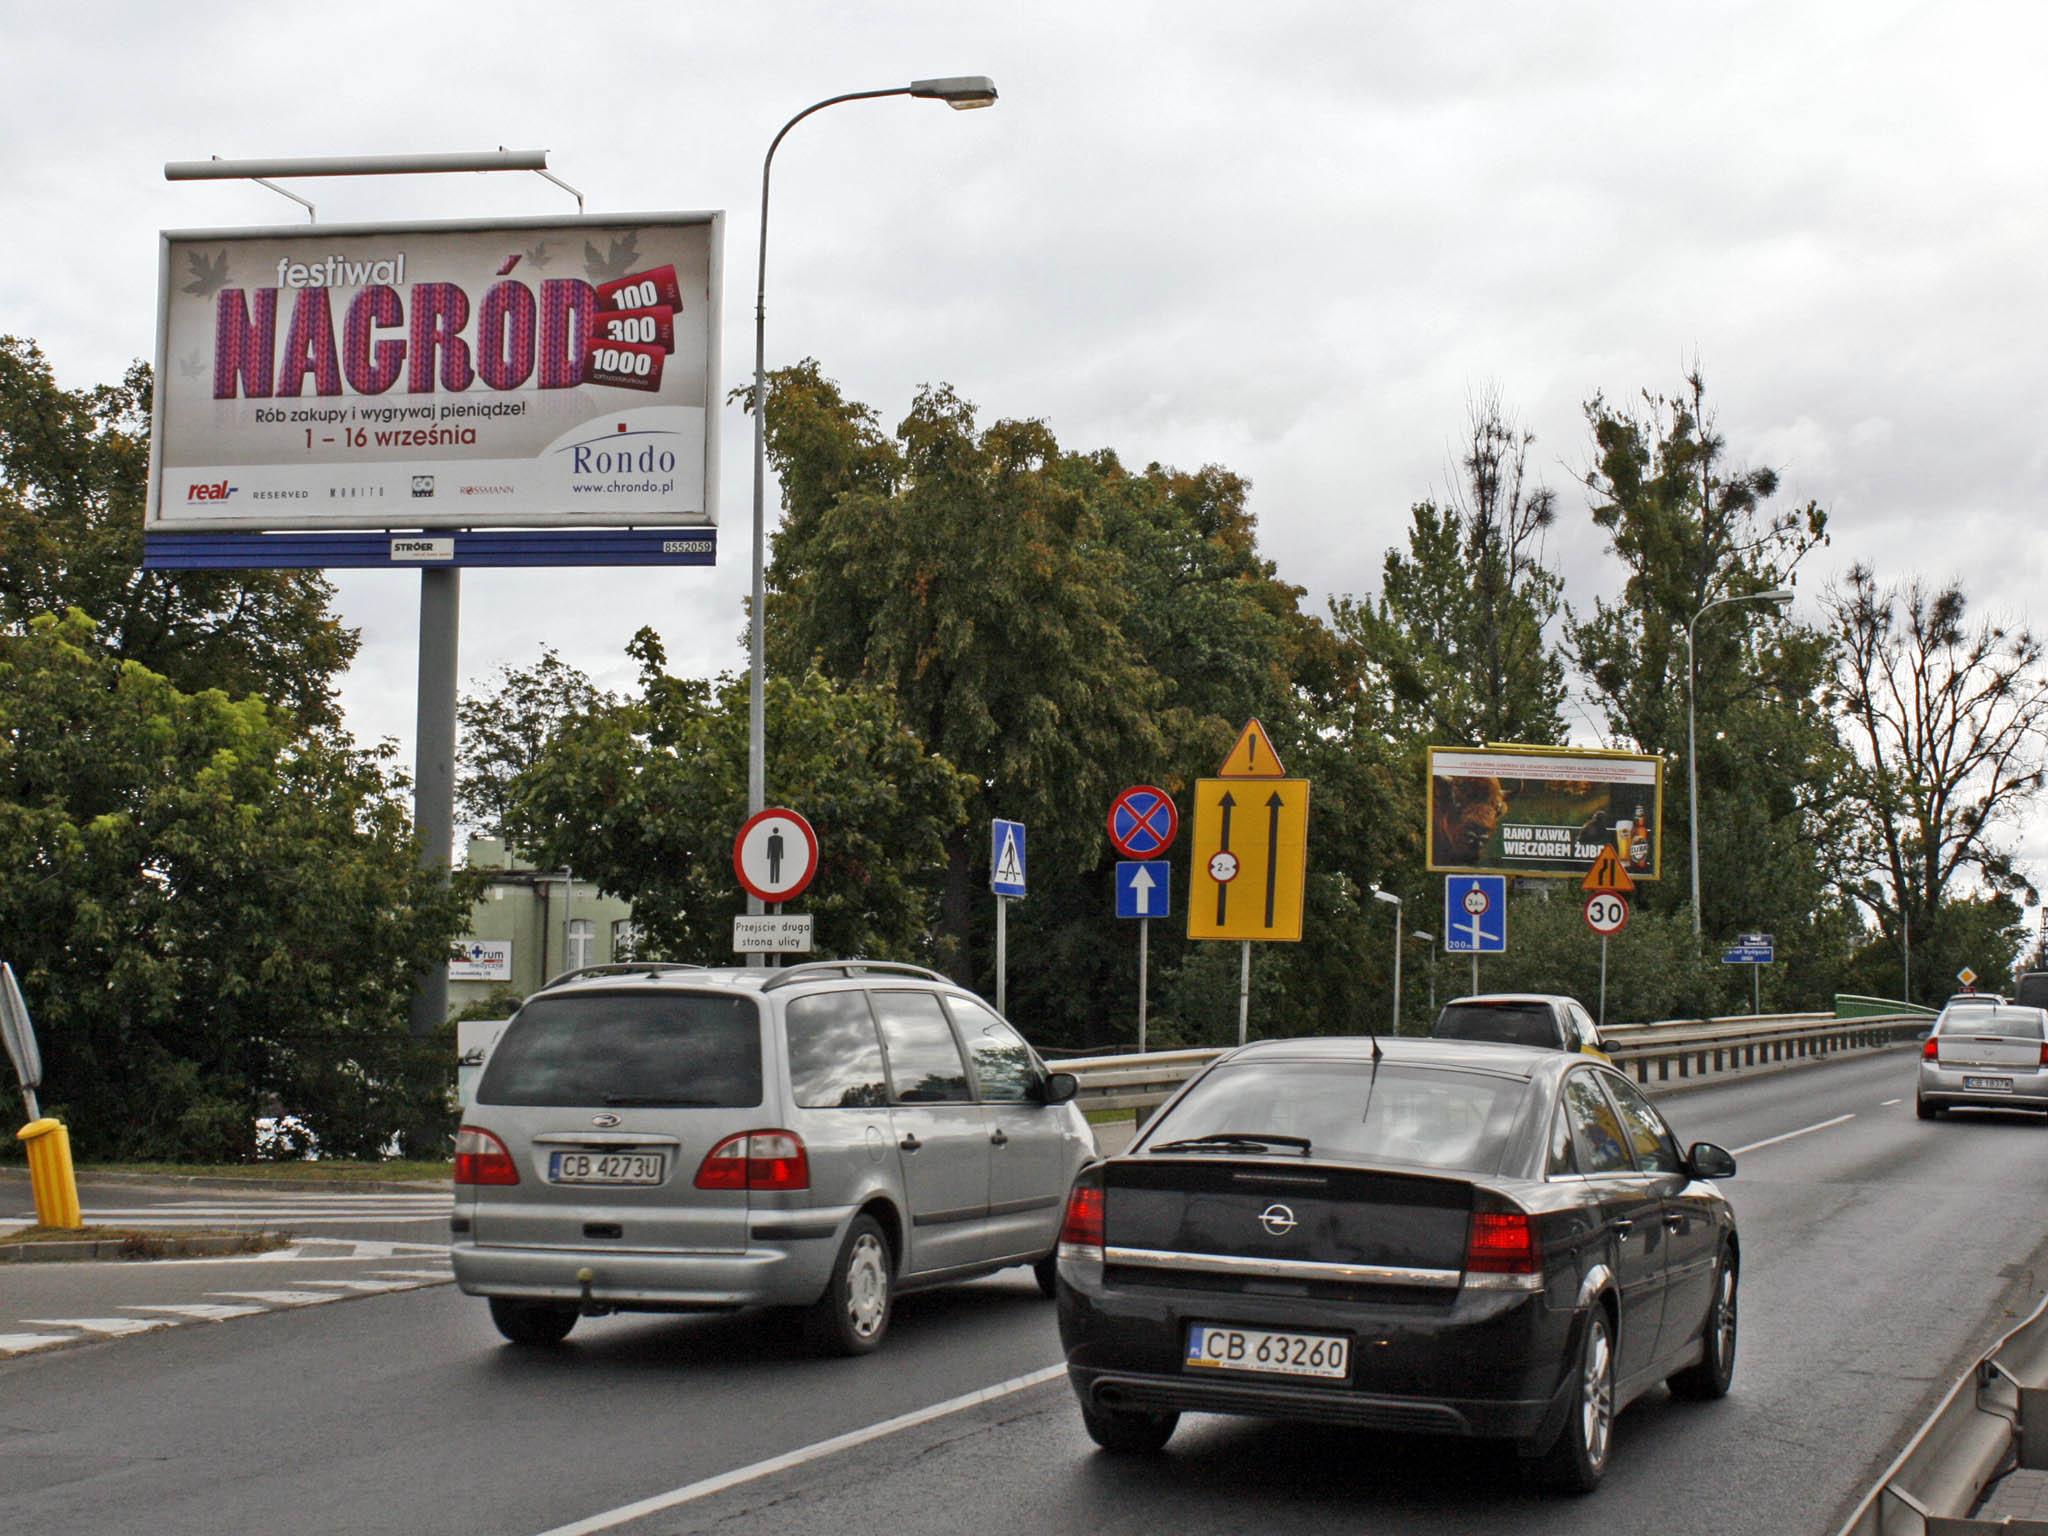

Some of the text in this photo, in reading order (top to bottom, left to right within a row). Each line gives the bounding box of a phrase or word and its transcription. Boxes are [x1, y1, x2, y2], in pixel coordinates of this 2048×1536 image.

[276, 252, 406, 289] festiwal
[611, 280, 658, 311] 100
[213, 254, 599, 400] NAGRÓD
[607, 316, 656, 343] 300
[592, 348, 652, 376] 1000
[255, 401, 526, 424] Rób zakupy i wygrywaj pieniądze!
[304, 428, 312, 449] 1
[344, 427, 368, 448] 16
[374, 423, 477, 447] września
[572, 445, 676, 474] Rondo
[252, 490, 309, 500] RESERVED
[459, 485, 515, 495] ROSSMANN
[572, 480, 674, 494] www.chrondo.pl
[664, 542, 711, 552] 8552059
[1503, 827, 1571, 841] RANO KAWKA
[1503, 841, 1571, 857] WIECZOREM
[1590, 901, 1622, 923] 30
[778, 937, 800, 948] ulicy
[563, 1156, 658, 1178] CB 4273U
[1207, 1331, 1246, 1360] CB
[1256, 1335, 1343, 1369] 63260
